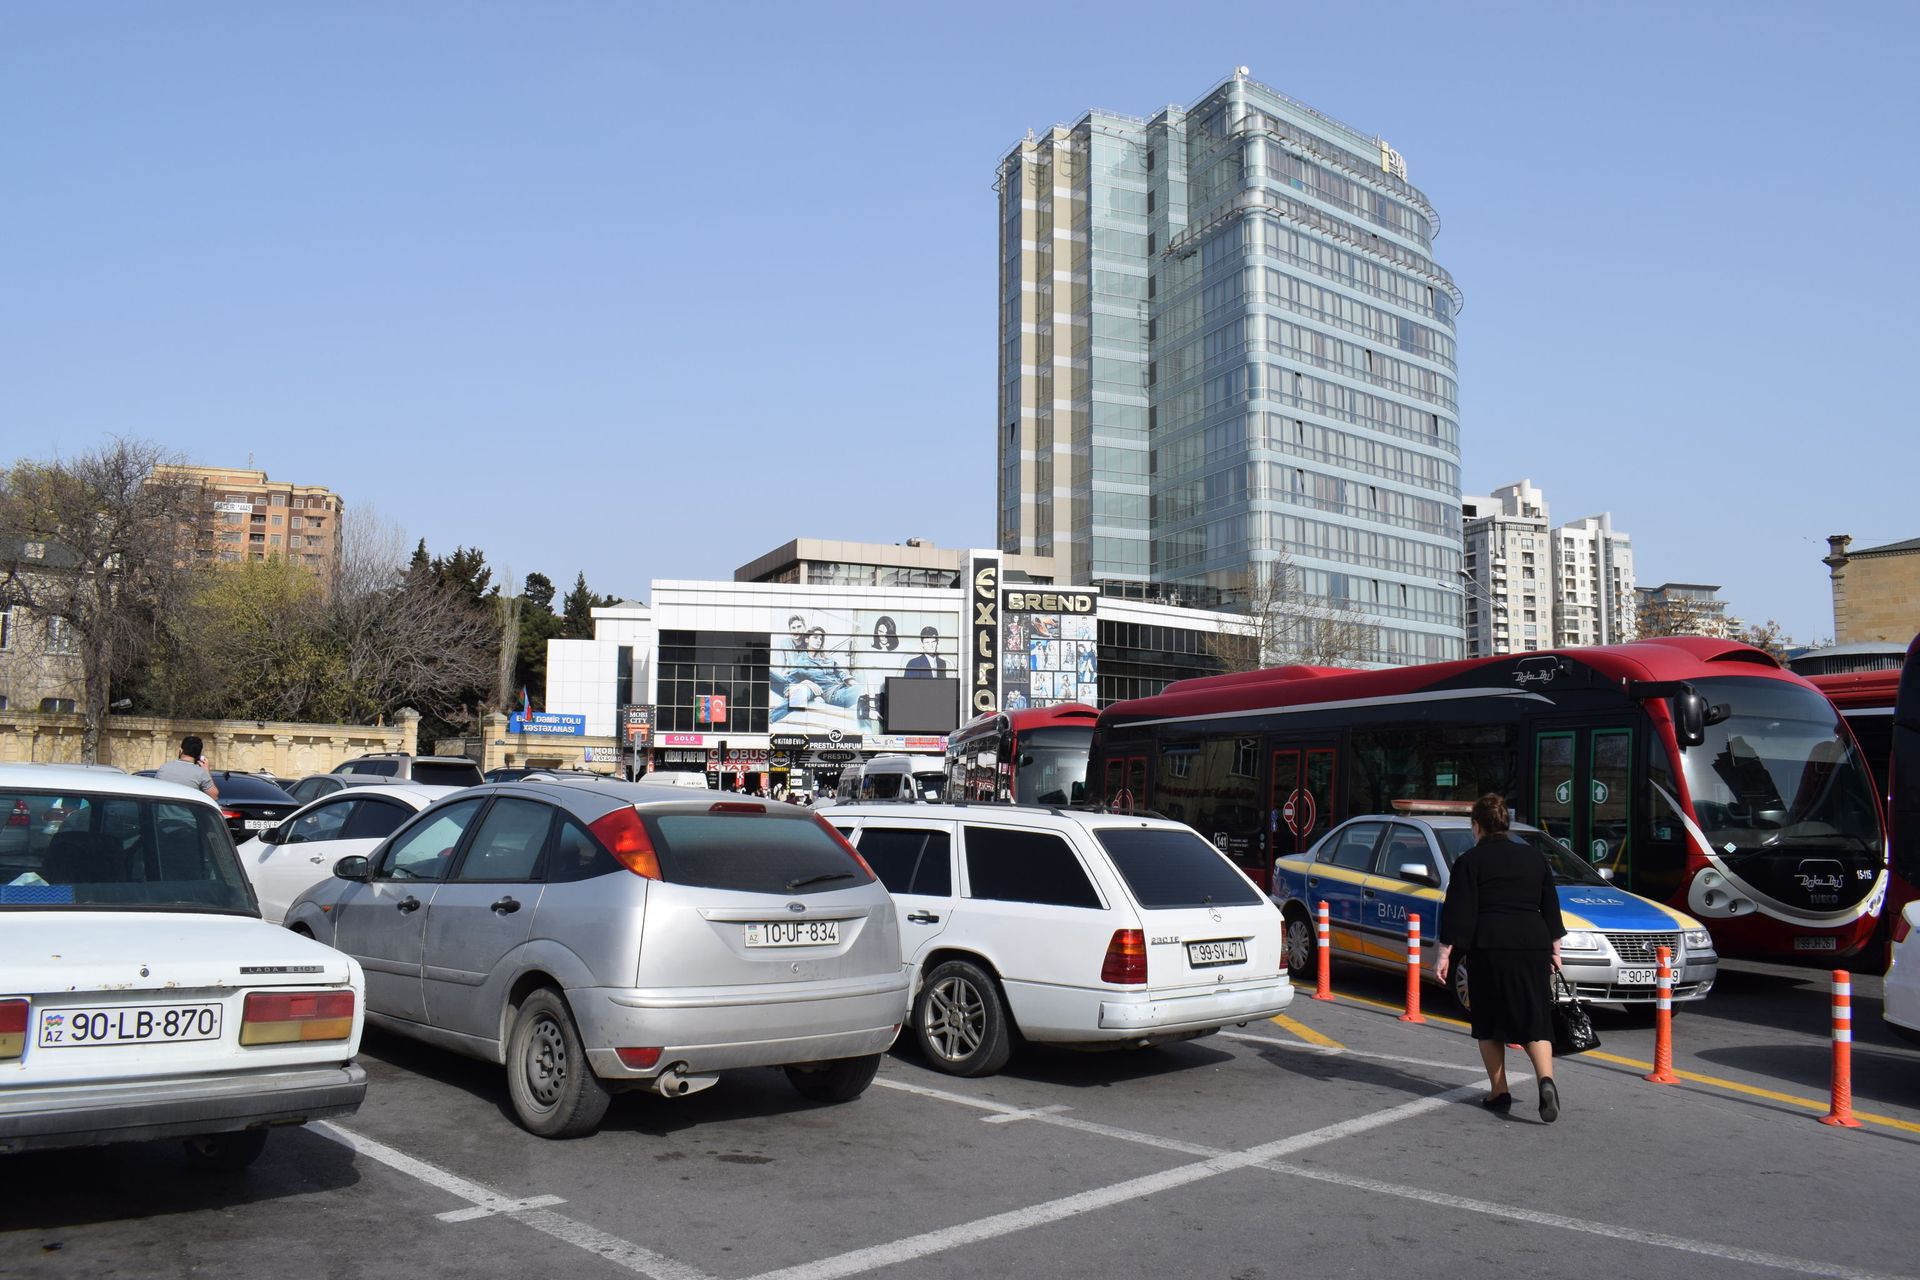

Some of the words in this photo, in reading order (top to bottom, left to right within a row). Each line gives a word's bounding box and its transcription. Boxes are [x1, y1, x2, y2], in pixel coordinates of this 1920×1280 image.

[1008, 592, 1092, 612] BREND
[561, 717, 581, 725] YOLU
[709, 749, 768, 759] GOBUS
[1216, 836, 1227, 847] 141
[1810, 894, 1839, 904] IVECO
[1378, 902, 1407, 921] BNA
[1199, 942, 1244, 961] 99-SV-471
[45, 1030, 63, 1043] AZ
[71, 1008, 214, 1041] 90-LB-870
